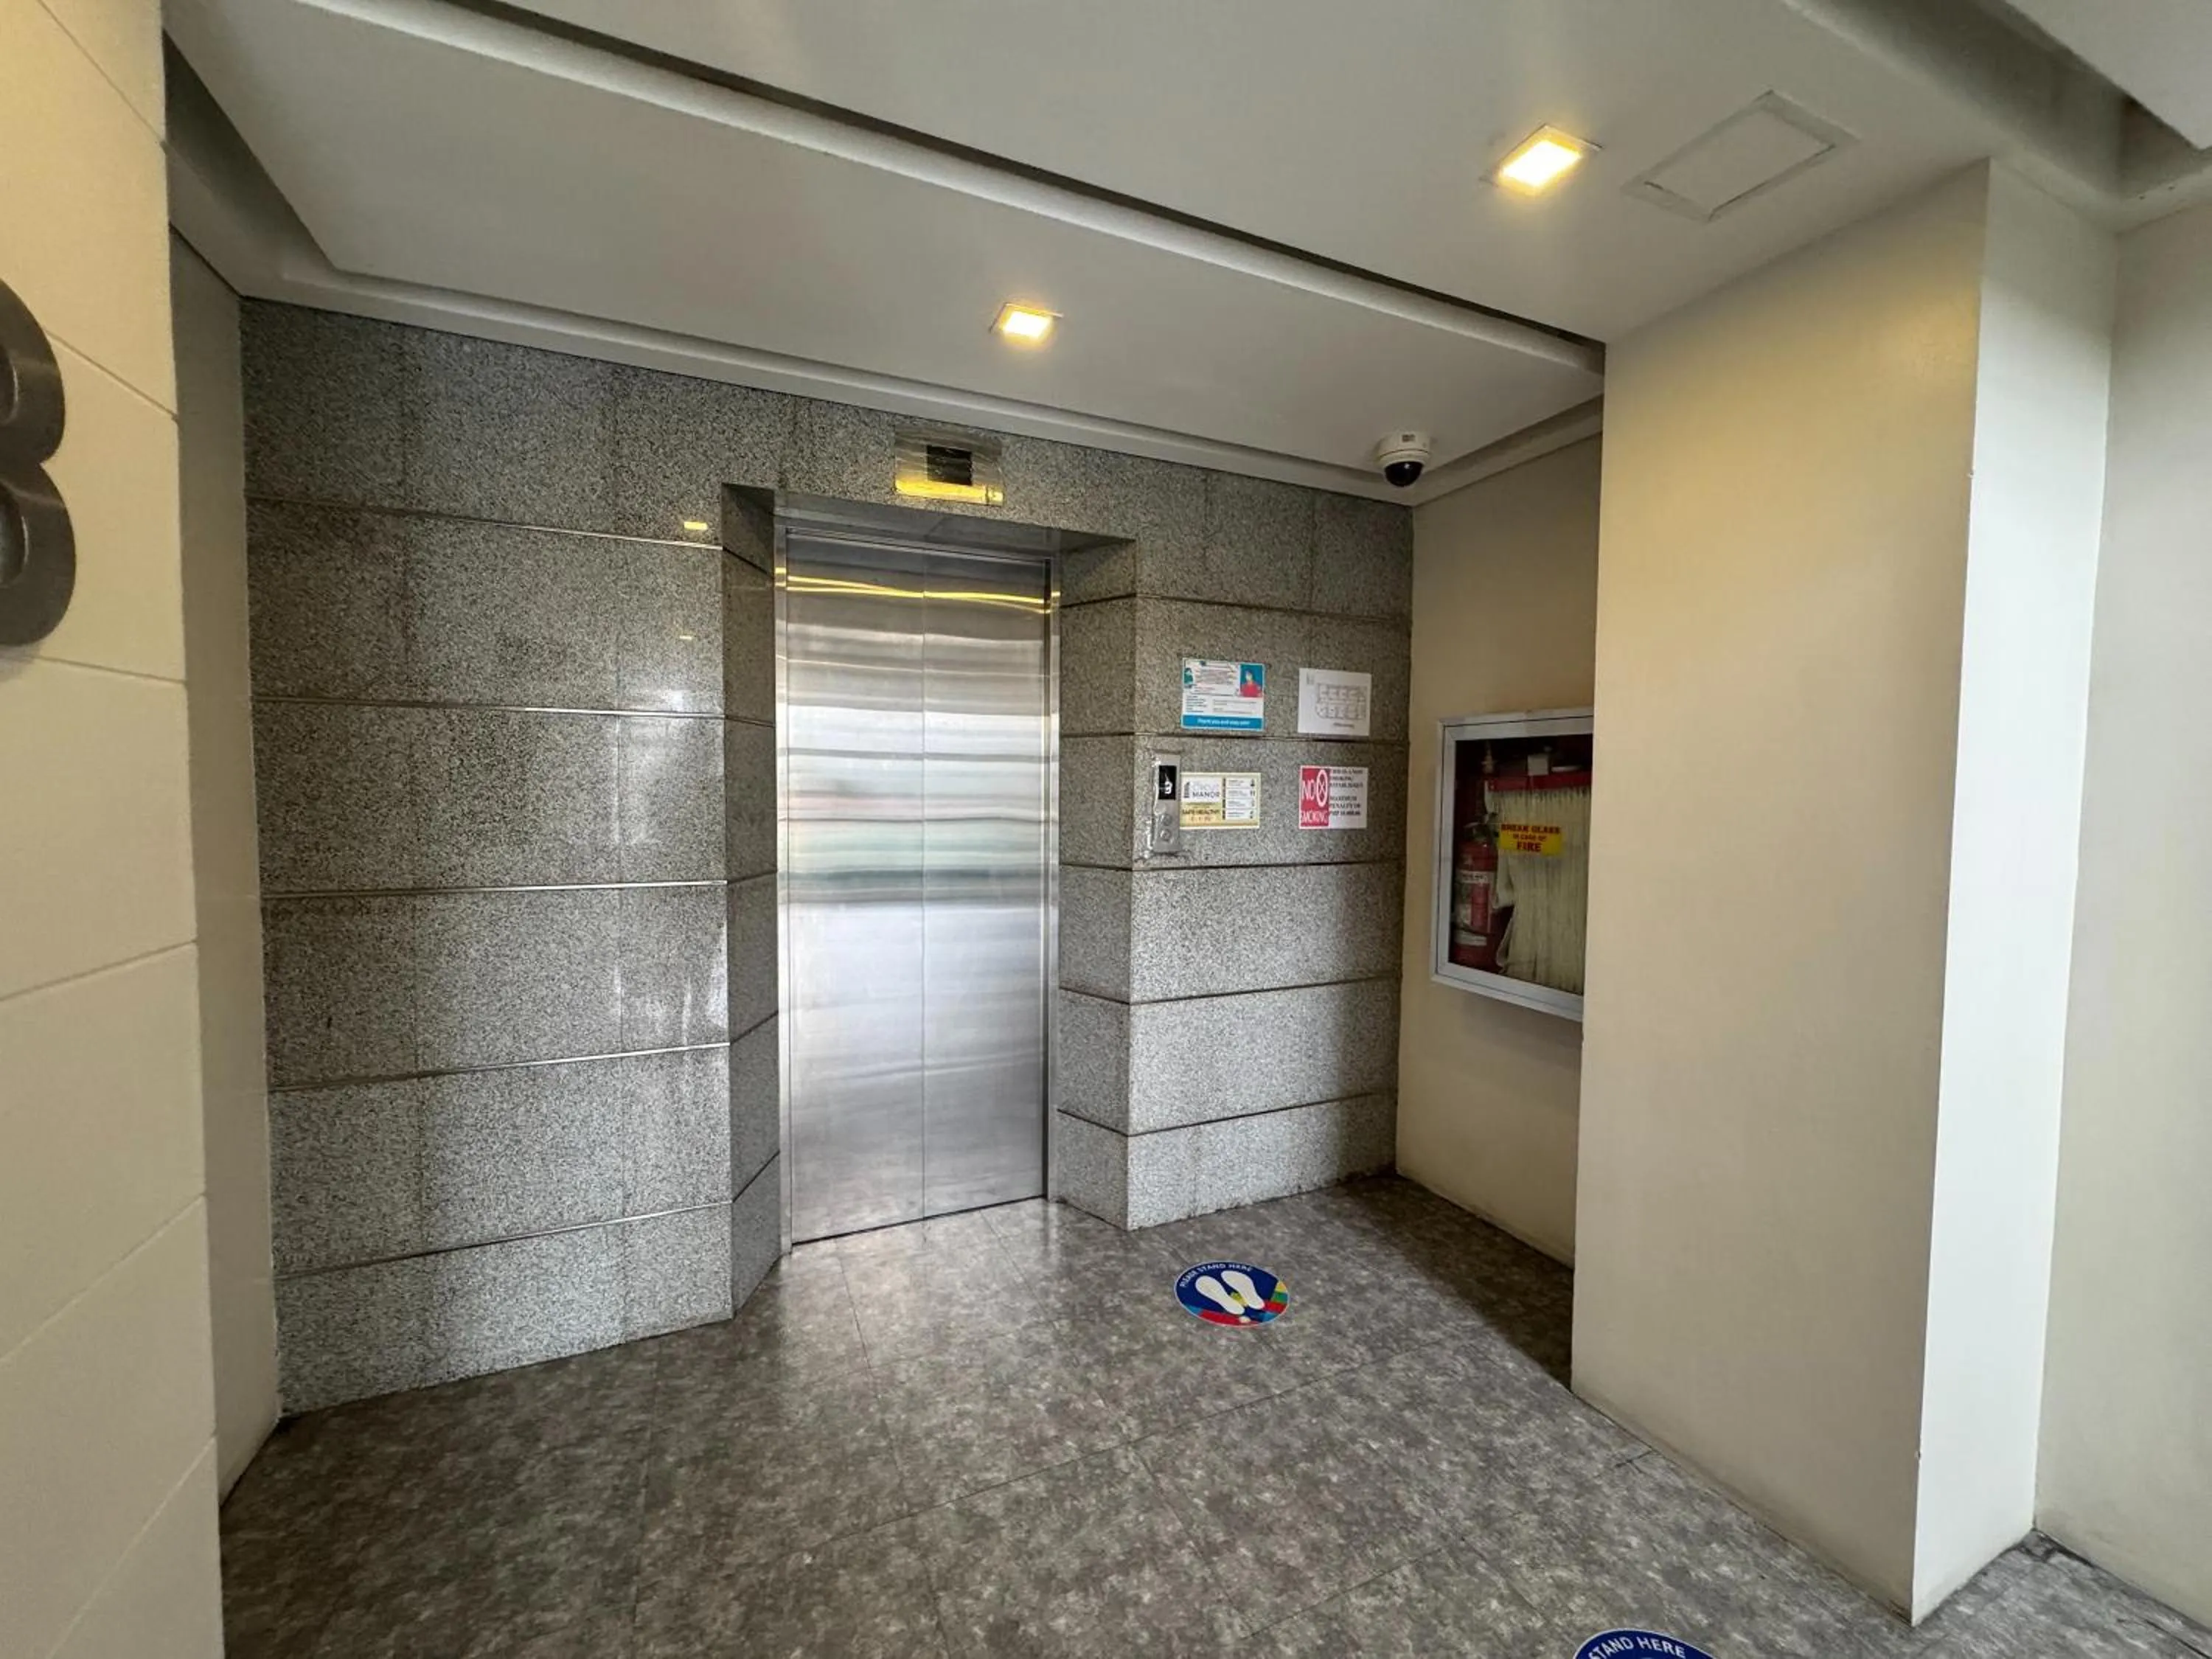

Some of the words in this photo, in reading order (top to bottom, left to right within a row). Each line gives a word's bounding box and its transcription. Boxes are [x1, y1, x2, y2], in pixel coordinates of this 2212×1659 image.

[1301, 779, 1315, 801] NO
[1301, 810, 1328, 824] SMOKING
[1517, 841, 1542, 852] FIRE
[1197, 1263, 1226, 1272] STAND
[1228, 1263, 1252, 1272] HERE
[1588, 1636, 1635, 1659] STAND
[1636, 1636, 1686, 1658] HERE
